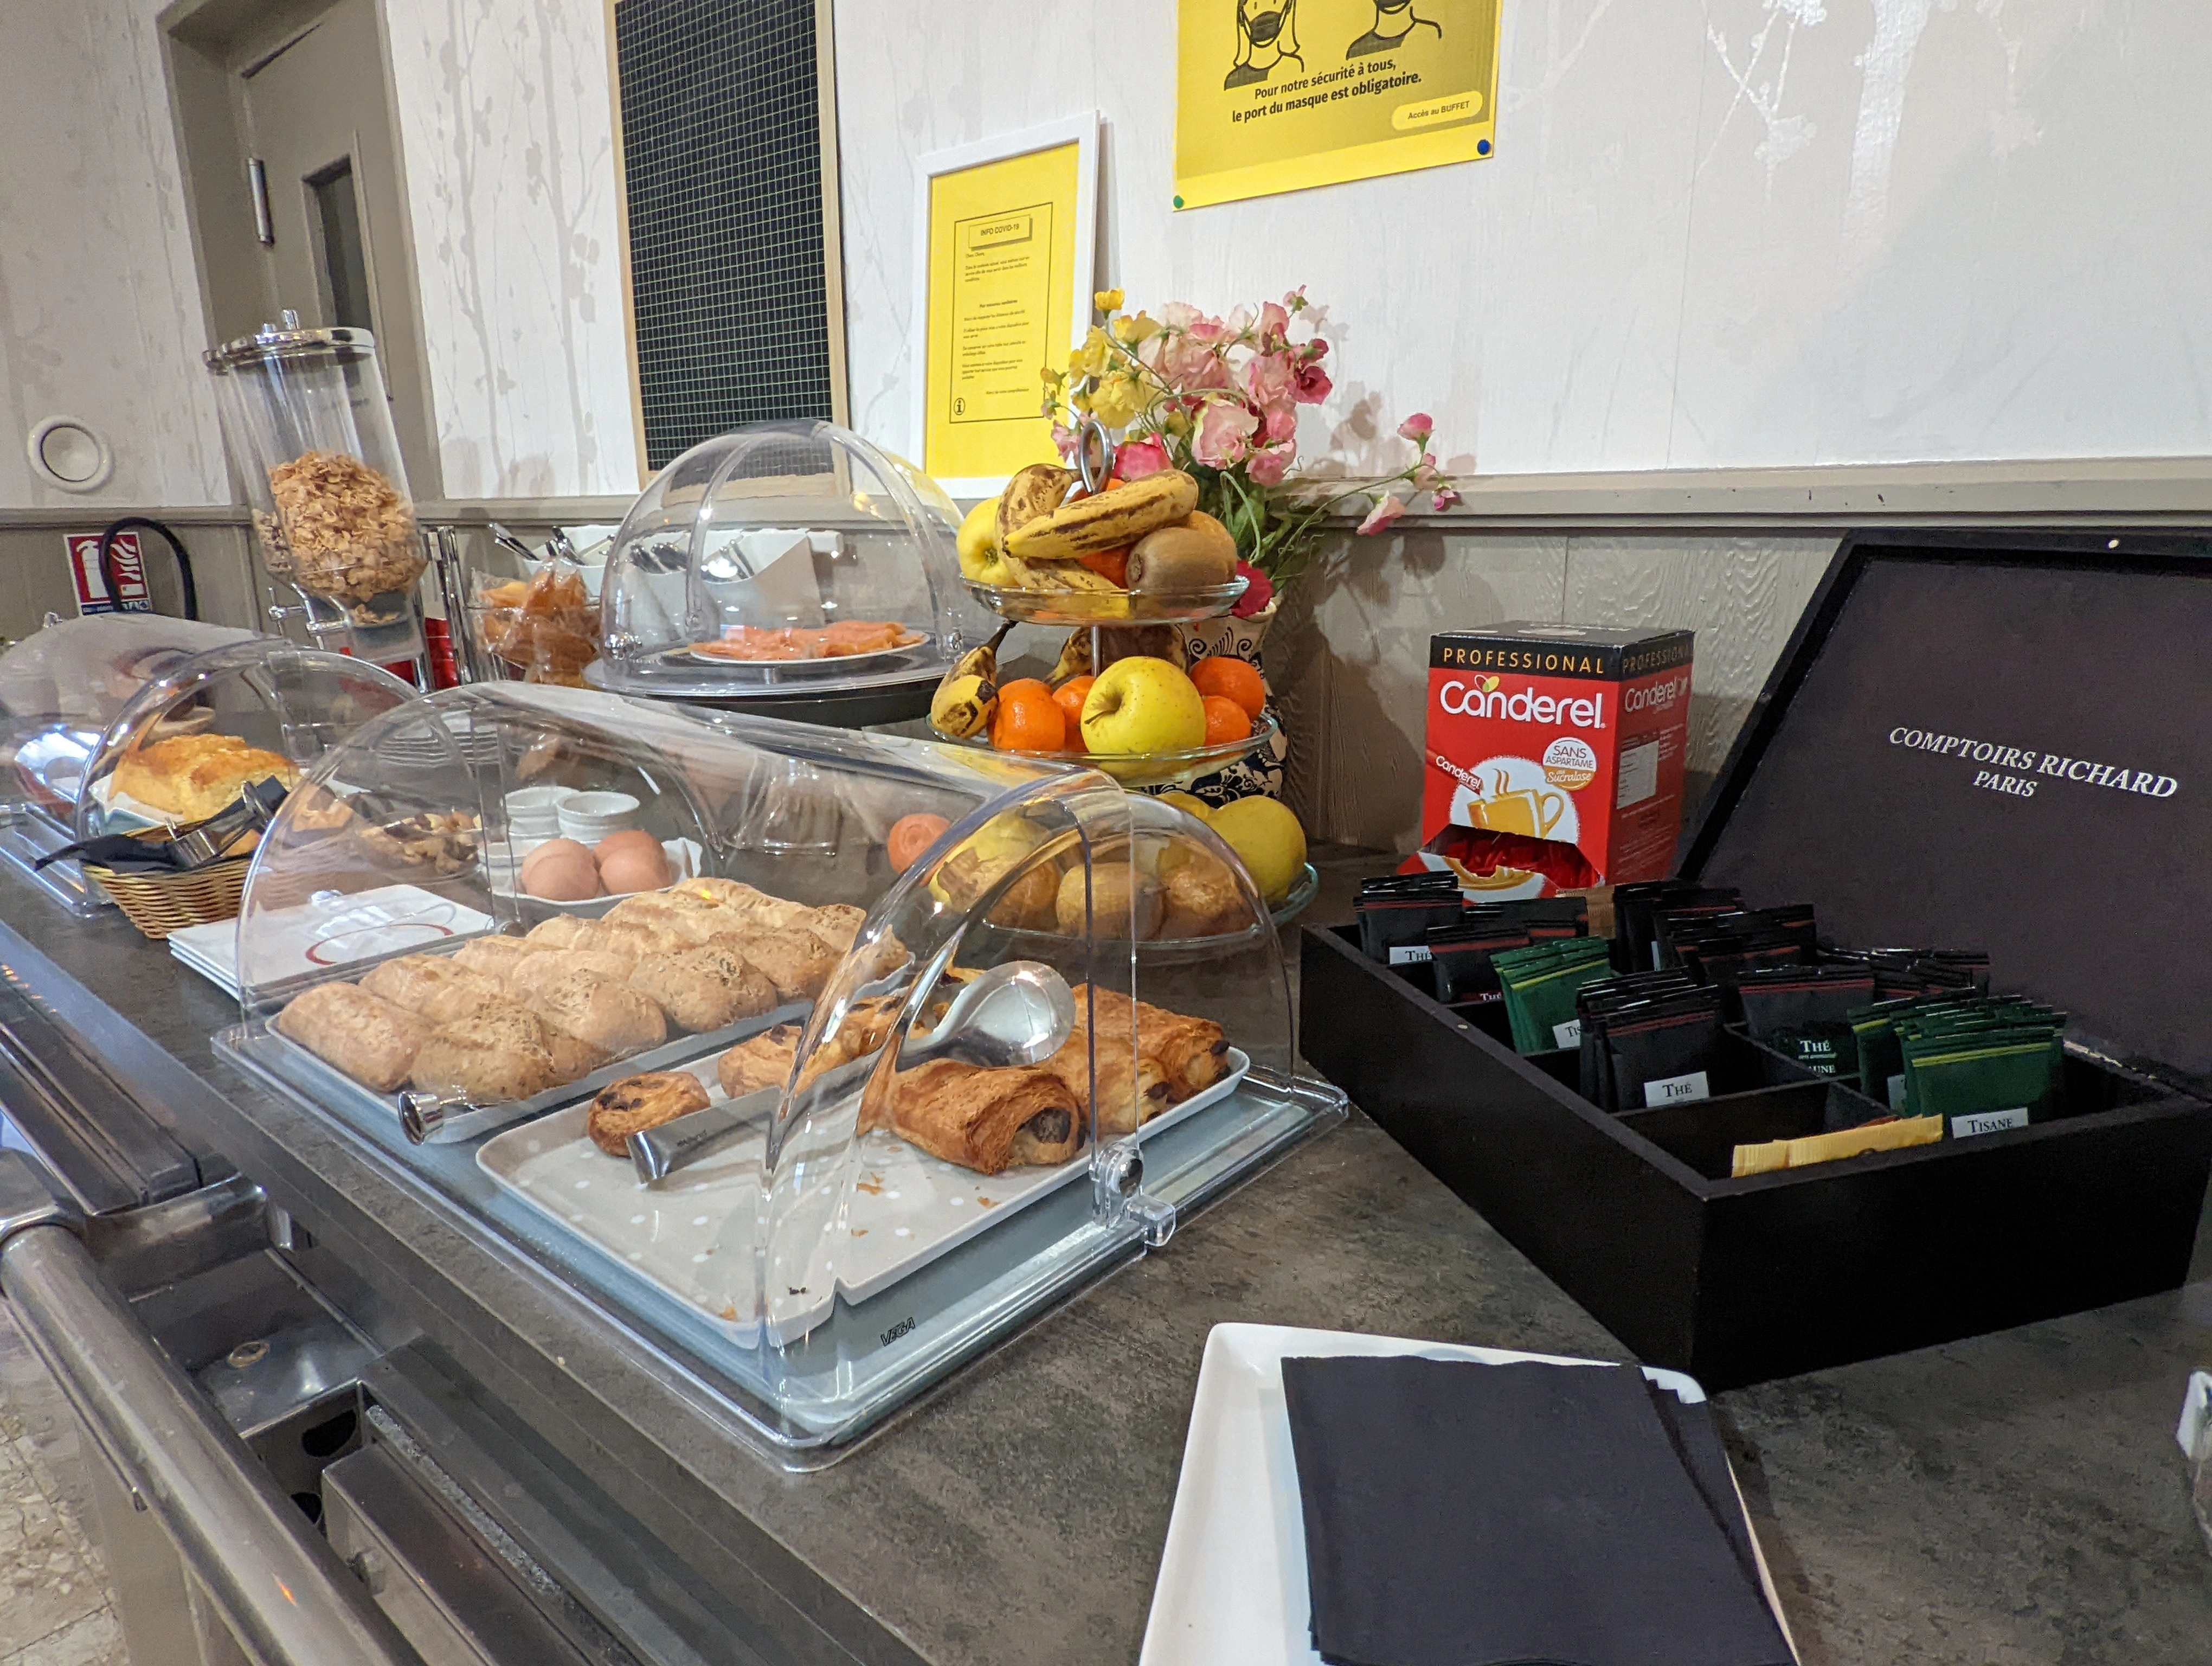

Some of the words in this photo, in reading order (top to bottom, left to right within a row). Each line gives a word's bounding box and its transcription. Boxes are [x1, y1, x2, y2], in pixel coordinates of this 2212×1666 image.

[1255, 86, 1278, 99] Pour
[1281, 79, 1308, 93] notre
[1311, 64, 1355, 87] sécurité
[1357, 62, 1364, 75] à
[1367, 59, 1396, 73] tous,
[1232, 110, 1242, 123] le
[1244, 105, 1267, 123] port
[1269, 101, 1283, 114] du
[1285, 93, 1328, 111] masque
[1330, 86, 1349, 100] est
[1352, 71, 1422, 96] obligatoire.
[1407, 110, 1429, 119] Accès
[1441, 100, 1470, 113] BUFFET
[980, 228, 994, 236] INFO
[994, 223, 1020, 234] COVID-19
[1443, 647, 1604, 674] PROFESSIONAL
[1439, 680, 1603, 729] Canderel
[1625, 676, 1676, 712] Canderel
[1546, 755, 1593, 768] ASPARTAME
[1553, 745, 1586, 758] SANS
[1889, 727, 2037, 770] COMPTOIRS
[2037, 754, 2178, 798] RICHARD
[1436, 755, 1481, 789] Canderel
[1973, 771, 2039, 798] PARIS
[880, 1317, 915, 1347] VEGA
